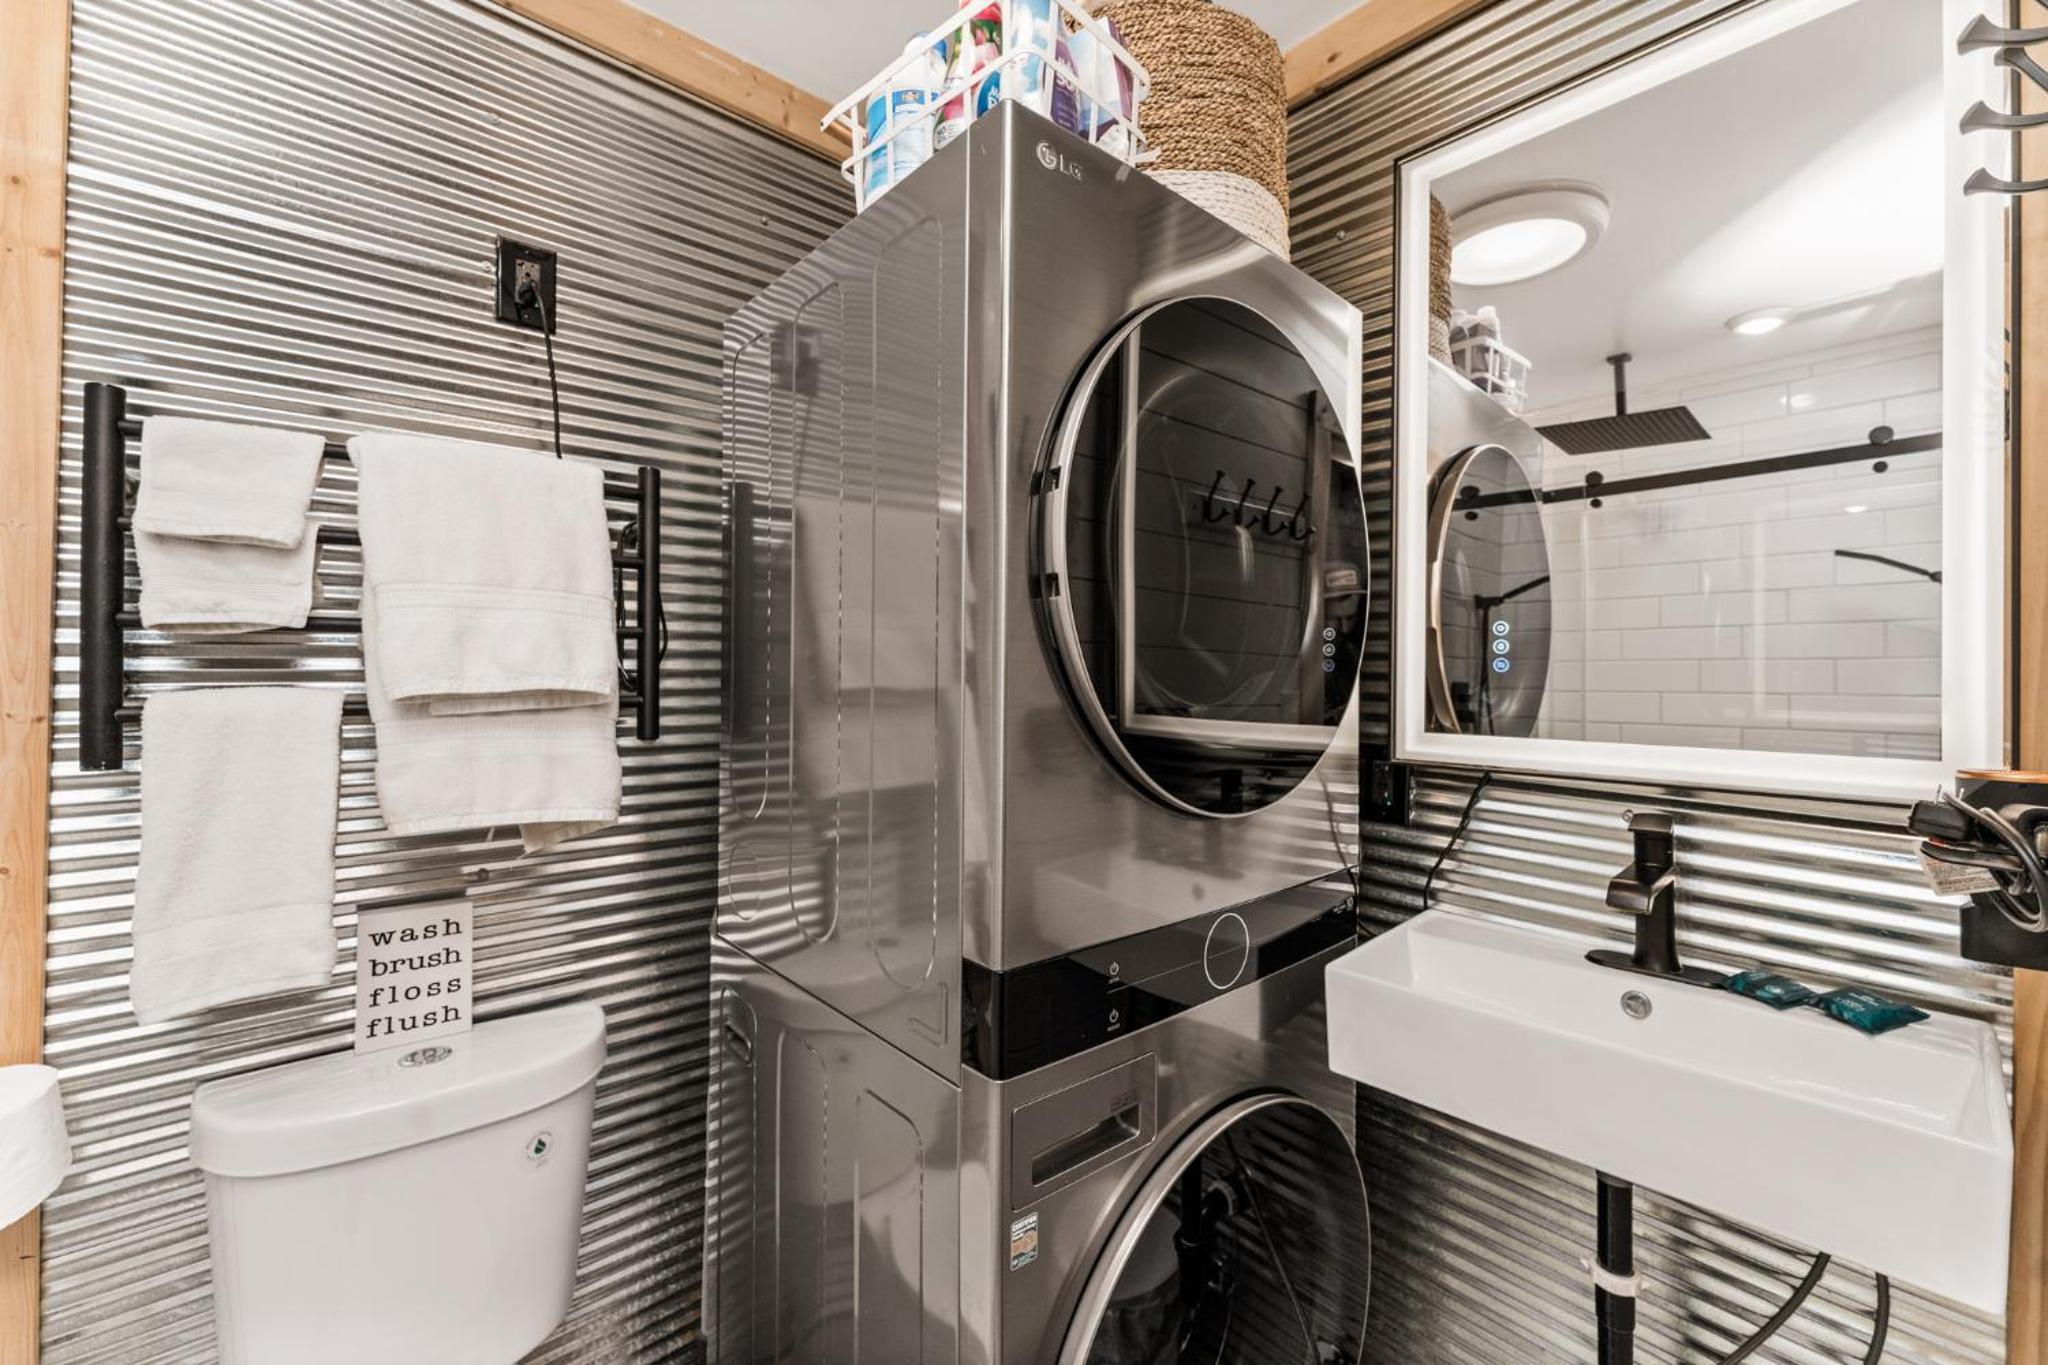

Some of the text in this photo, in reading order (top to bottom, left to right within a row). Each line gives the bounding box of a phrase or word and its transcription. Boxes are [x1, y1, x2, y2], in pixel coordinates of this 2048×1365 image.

[368, 918, 463, 947] wash
[368, 947, 463, 977] brush
[368, 977, 462, 1008] floss
[365, 1005, 462, 1039] flush
